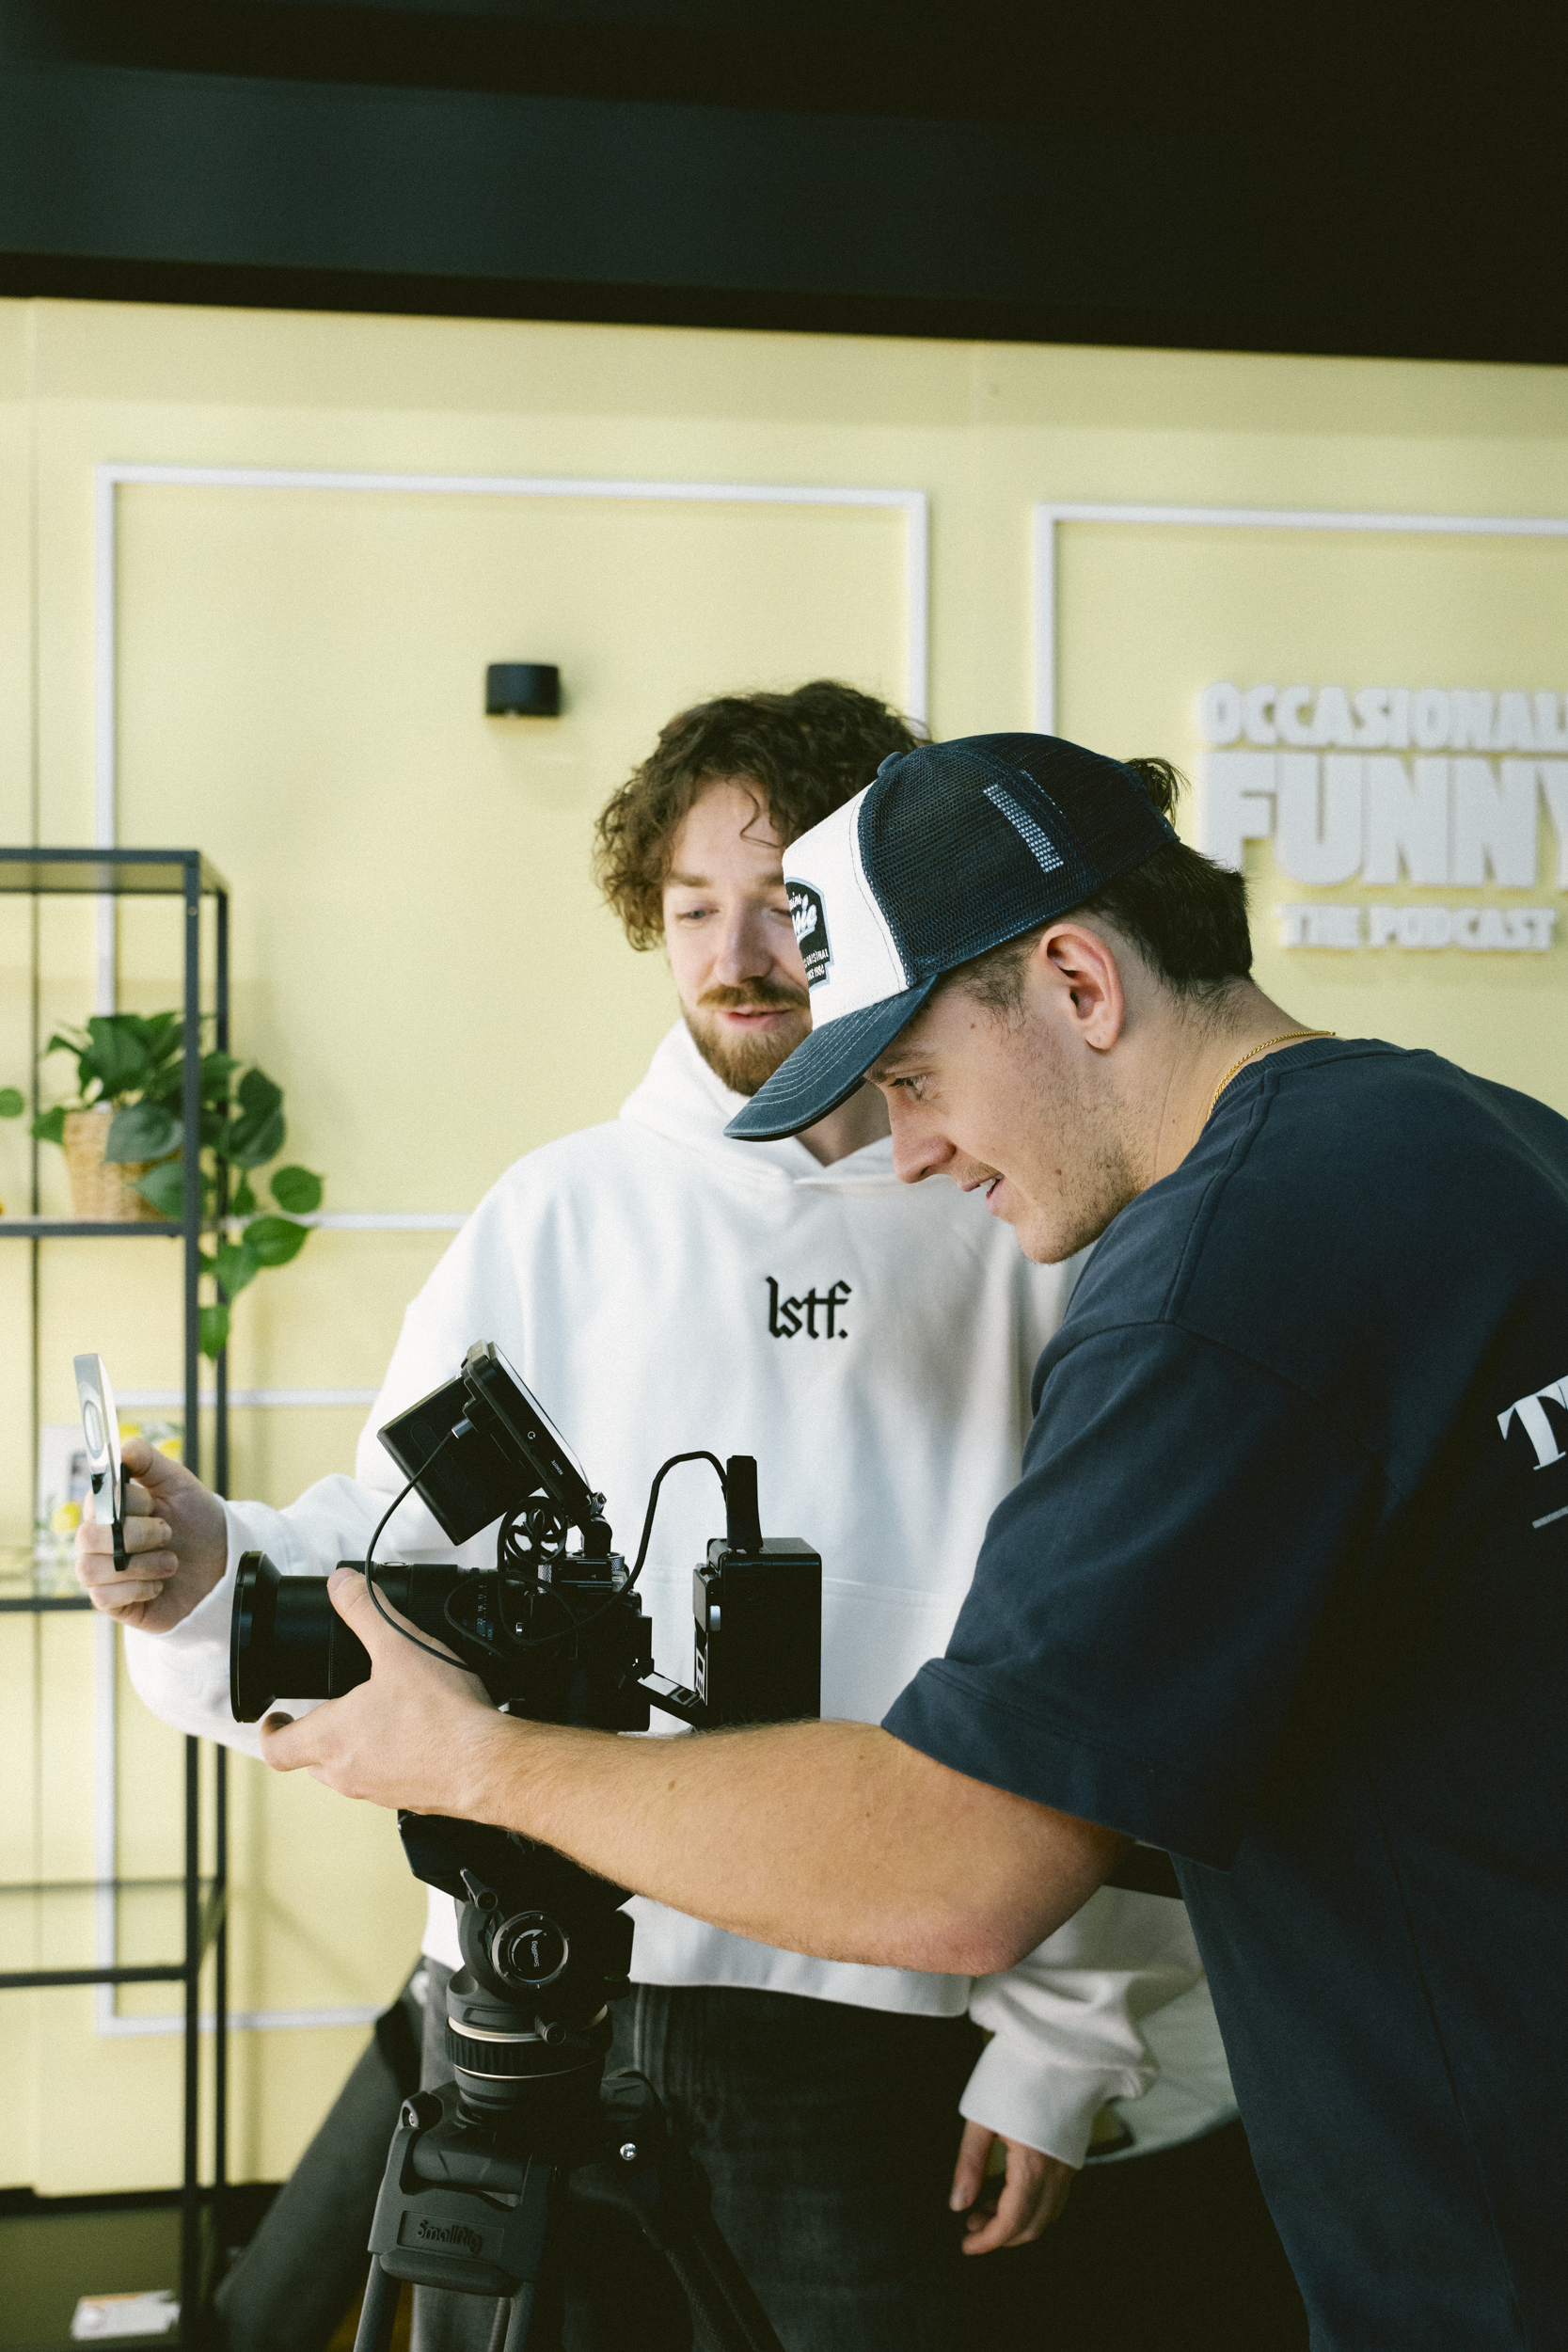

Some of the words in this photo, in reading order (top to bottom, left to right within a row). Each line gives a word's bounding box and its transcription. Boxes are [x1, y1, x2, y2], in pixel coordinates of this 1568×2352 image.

[1199, 680, 1568, 751] OCCASIONAL
[1279, 903, 1360, 948] THE
[1368, 904, 1556, 951] PODCAST
[477, 1617, 483, 1626] 22
[417, 2219, 483, 2255] SmallRig
